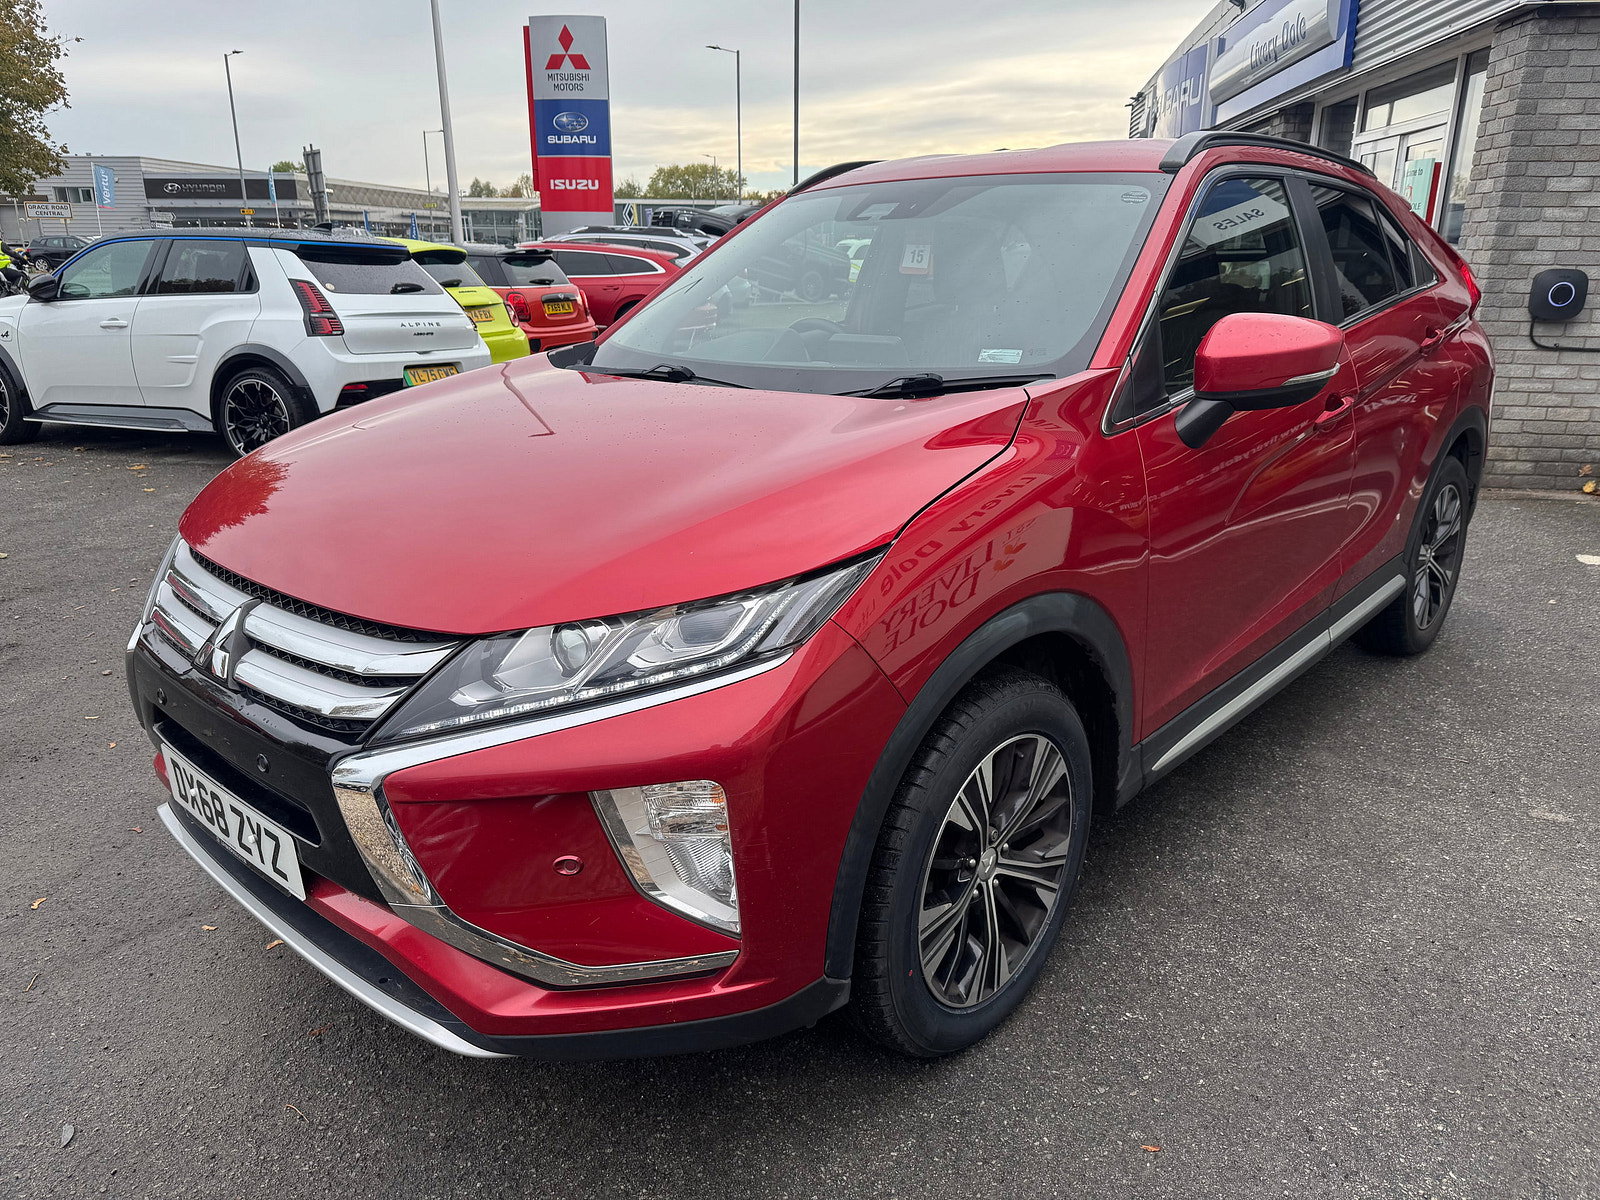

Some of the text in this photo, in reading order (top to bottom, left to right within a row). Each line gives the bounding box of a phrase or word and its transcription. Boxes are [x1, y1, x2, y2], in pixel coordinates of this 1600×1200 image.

[1251, 12, 1306, 69] Livery Dole
[547, 73, 590, 82] MITSUBISHI
[553, 83, 584, 91] MOTORS
[547, 135, 597, 144] SUBARU
[182, 184, 226, 192] HYUNDAI
[550, 179, 599, 190] ISUZU
[910, 249, 924, 265] 15
[410, 369, 438, 383] YL75
[170, 757, 289, 882] DX68 ZYZ
